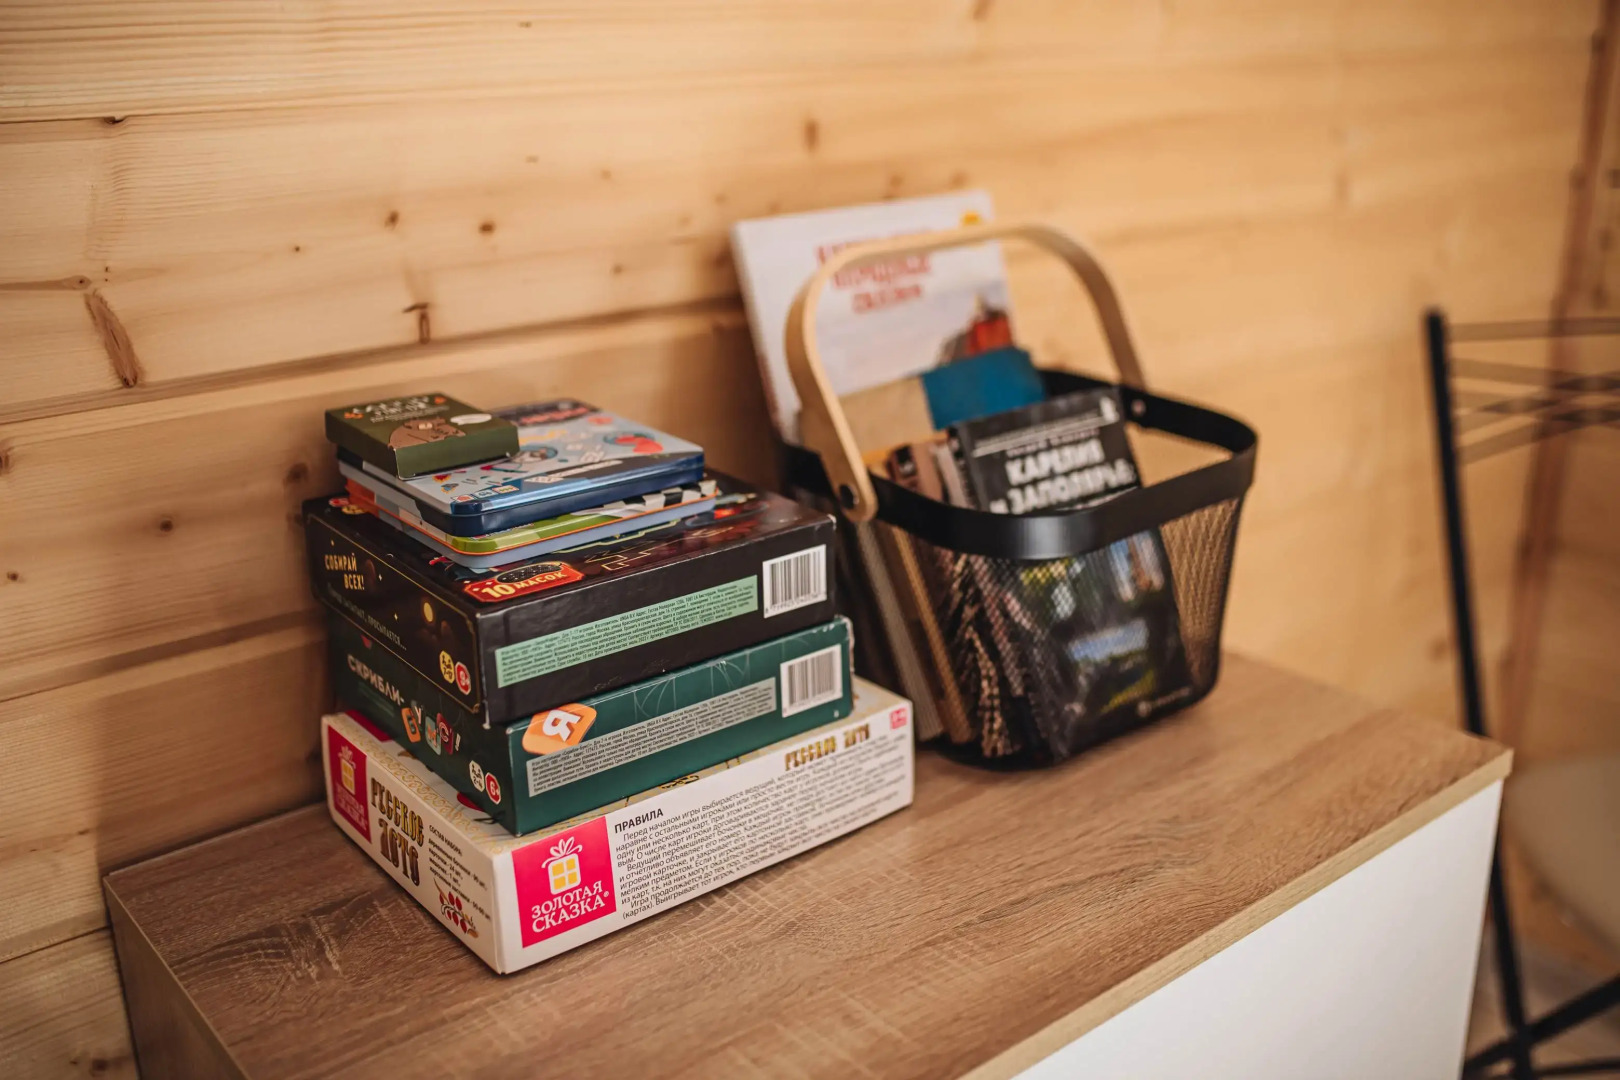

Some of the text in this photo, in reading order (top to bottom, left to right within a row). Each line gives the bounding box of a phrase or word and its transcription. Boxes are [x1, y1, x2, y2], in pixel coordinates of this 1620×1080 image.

[324, 552, 358, 572] СОБИРАЙ
[343, 573, 365, 590] ВСЕХ!
[481, 571, 568, 598] 10 МАСОК
[490, 783, 500, 796] 6+
[614, 806, 663, 834] ПРАВИЛА
[615, 835, 647, 854] наравне
[654, 815, 699, 837] остальными
[623, 825, 647, 843] Перед
[649, 814, 680, 832] началом
[682, 807, 700, 820] игры
[616, 848, 634, 862] одну
[636, 842, 650, 852] или
[652, 826, 690, 846] несколько
[617, 855, 635, 867] вым.
[636, 850, 642, 860] О
[644, 843, 666, 857] числе
[668, 836, 684, 849] карт
[686, 826, 711, 842] игроки
[625, 861, 663, 880] отчетливо
[665, 843, 703, 864] объявляет
[705, 839, 717, 848] его
[627, 852, 660, 873] Ведущий
[662, 832, 715, 859] перемешивает
[620, 871, 651, 891] игровой
[653, 858, 688, 878] карточке,
[696, 841, 732, 860] закрывает
[620, 881, 649, 897] мелким
[651, 864, 692, 886] предметом.
[695, 854, 711, 867] Если
[621, 897, 630, 905] из
[632, 889, 649, 902] карт,
[673, 874, 686, 883] них
[688, 865, 707, 879] могут
[531, 878, 602, 920] ЗОЛОТАЯ
[622, 900, 653, 920] (картах).
[655, 881, 698, 907] Выигрывает
[701, 878, 711, 886] тот
[630, 894, 648, 910] Игра
[650, 874, 702, 901] продолжается
[704, 870, 712, 879] до
[531, 890, 605, 935] СКАЗКА
